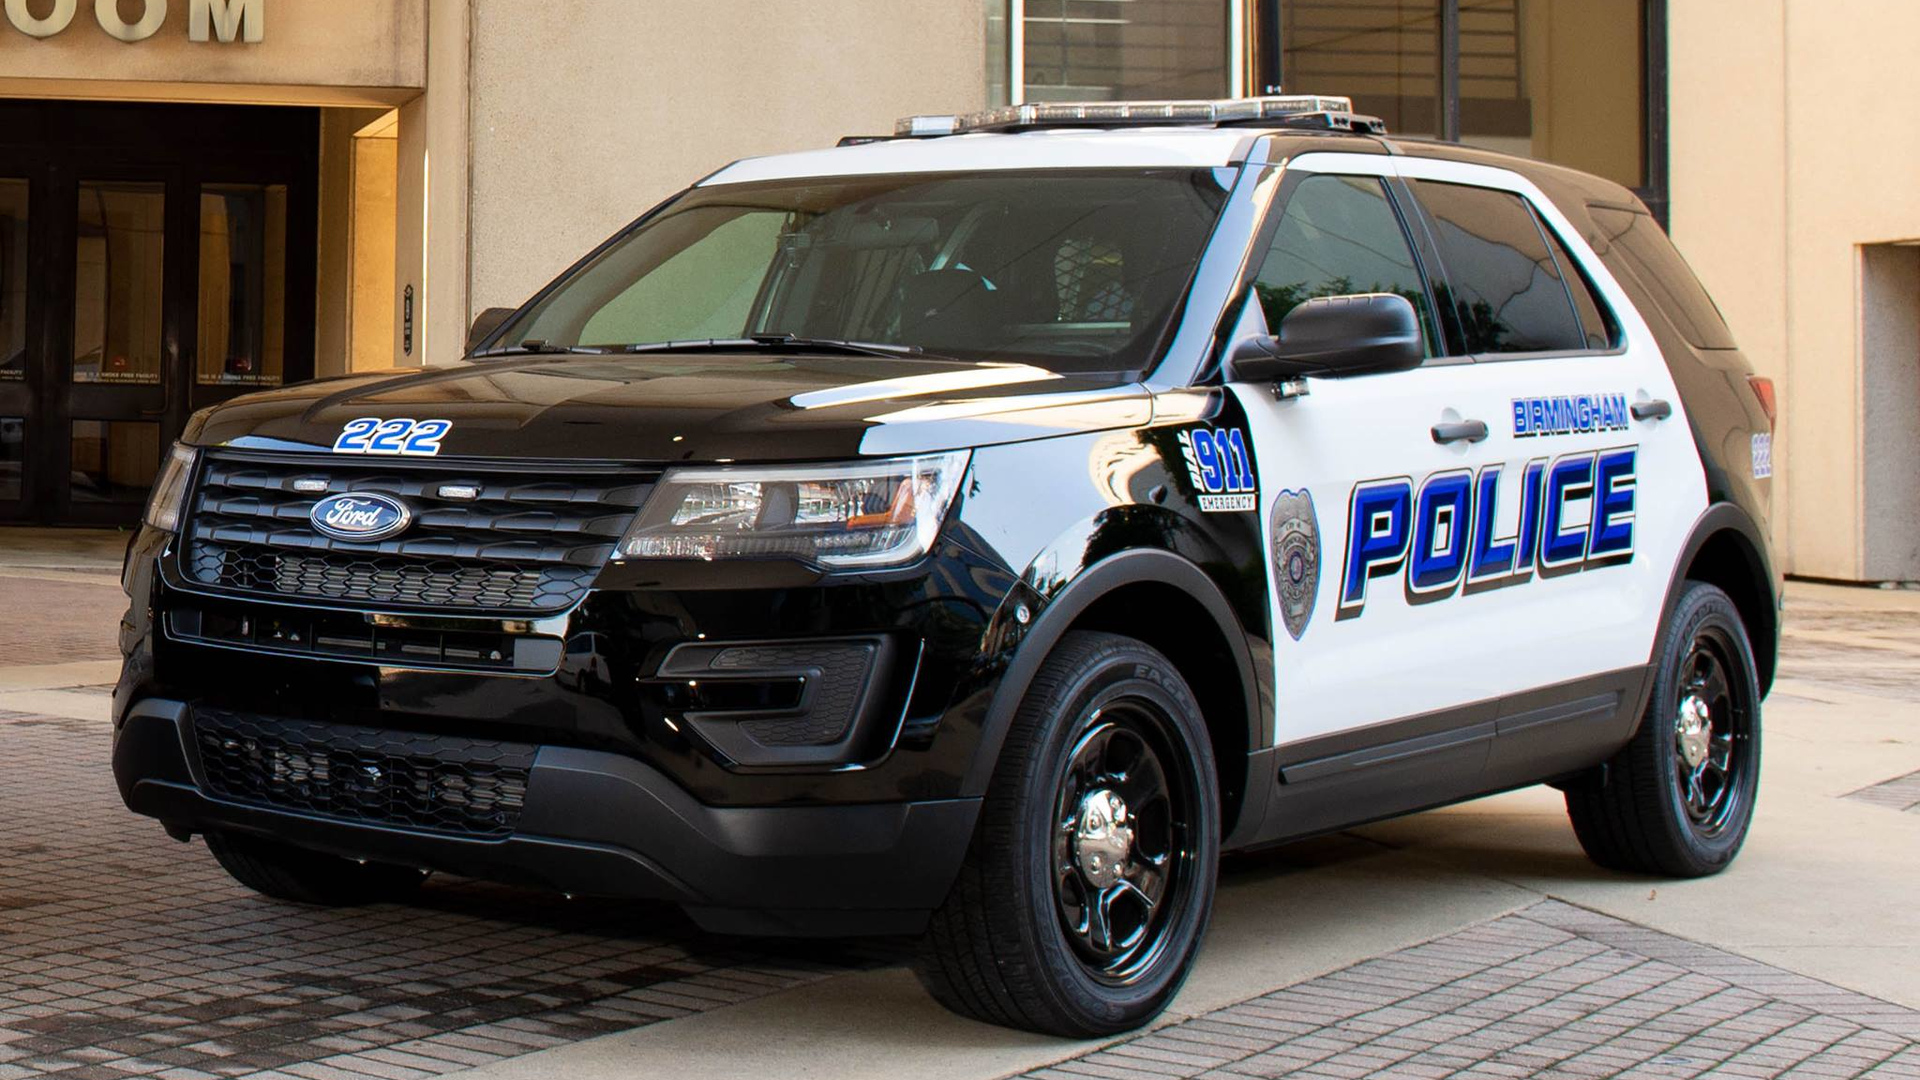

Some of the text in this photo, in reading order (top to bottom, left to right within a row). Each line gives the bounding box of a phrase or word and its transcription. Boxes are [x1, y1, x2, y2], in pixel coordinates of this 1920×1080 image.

[333, 418, 453, 456] 222
[1511, 394, 1628, 438] BIRMINGHAM
[1177, 429, 1206, 493] DIAL
[1191, 428, 1255, 493] 911
[326, 498, 383, 527] Ford
[1200, 496, 1254, 510] EMERGENCY
[1335, 445, 1639, 622] POLICE
